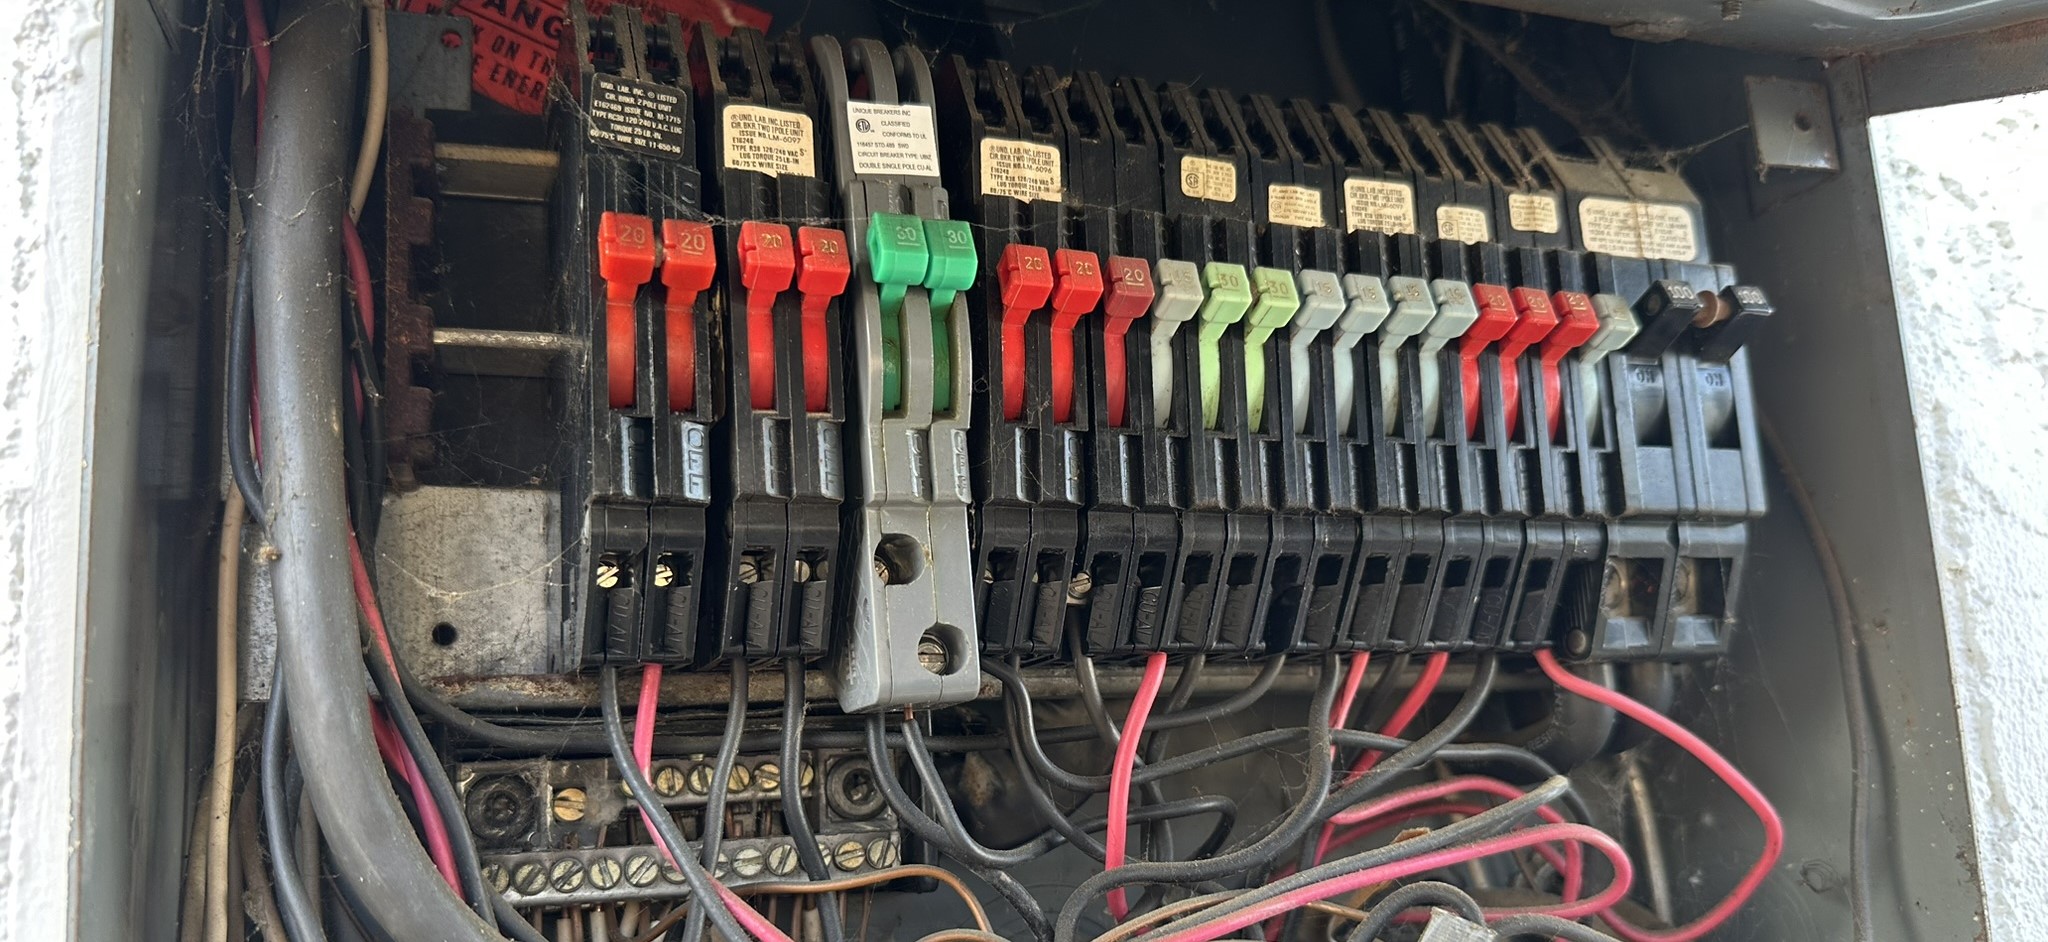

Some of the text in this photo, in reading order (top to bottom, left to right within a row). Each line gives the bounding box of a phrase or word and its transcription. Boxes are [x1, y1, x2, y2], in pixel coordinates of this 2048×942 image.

[482, 0, 564, 40] ANG
[491, 35, 521, 61] ON
[489, 62, 546, 101] ENER
[617, 85, 631, 93] LAB.
[632, 88, 646, 96] INC.
[657, 93, 678, 104] LISTED
[624, 106, 642, 115] ISSUE
[643, 110, 655, 118] NO.
[637, 98, 643, 106] 2
[642, 100, 658, 109] POLE
[657, 104, 672, 112] UNIT
[852, 107, 872, 115] UNIQUE
[873, 108, 901, 116] BREAKERS
[592, 109, 607, 119] TYPE
[670, 125, 683, 134] LUG
[779, 119, 801, 129] LISTED
[880, 120, 911, 128] CLASSIFIED
[610, 123, 633, 134] TORQUE
[634, 127, 643, 135] 25
[757, 123, 770, 132] TWO
[789, 129, 804, 137] UNIT
[882, 131, 911, 140] CONFORMS
[617, 135, 632, 144] WIRE
[634, 137, 647, 146] SIZE
[732, 144, 747, 152] TYPE
[787, 149, 799, 157] VAC
[752, 153, 774, 161] TORQUE
[1032, 150, 1052, 159] LISTED
[758, 161, 774, 169] WIRE
[775, 163, 789, 171] SIZE
[881, 162, 901, 170] SINGLE
[996, 161, 1012, 169] ISSUE
[1041, 160, 1054, 168] UNIT
[990, 173, 1003, 181] TYPE
[1038, 178, 1049, 187] VAC
[1008, 182, 1028, 190] TORQUE
[1013, 189, 1028, 197] WIRE
[1028, 191, 1040, 199] SIZE
[620, 224, 646, 244] 20
[681, 231, 707, 251] 20
[761, 233, 784, 249] 20
[896, 226, 917, 242] 30
[947, 230, 968, 245] 30
[820, 239, 840, 254] 20
[1025, 256, 1044, 271] 20
[1075, 261, 1094, 276] 20
[1123, 267, 1145, 282] 20
[1220, 273, 1240, 288] 30
[1270, 280, 1290, 296] 30
[1316, 281, 1333, 294] 15
[1667, 285, 1696, 300] 100
[1487, 294, 1506, 308] 20
[1527, 296, 1546, 309] 20
[687, 427, 706, 494] OFF
